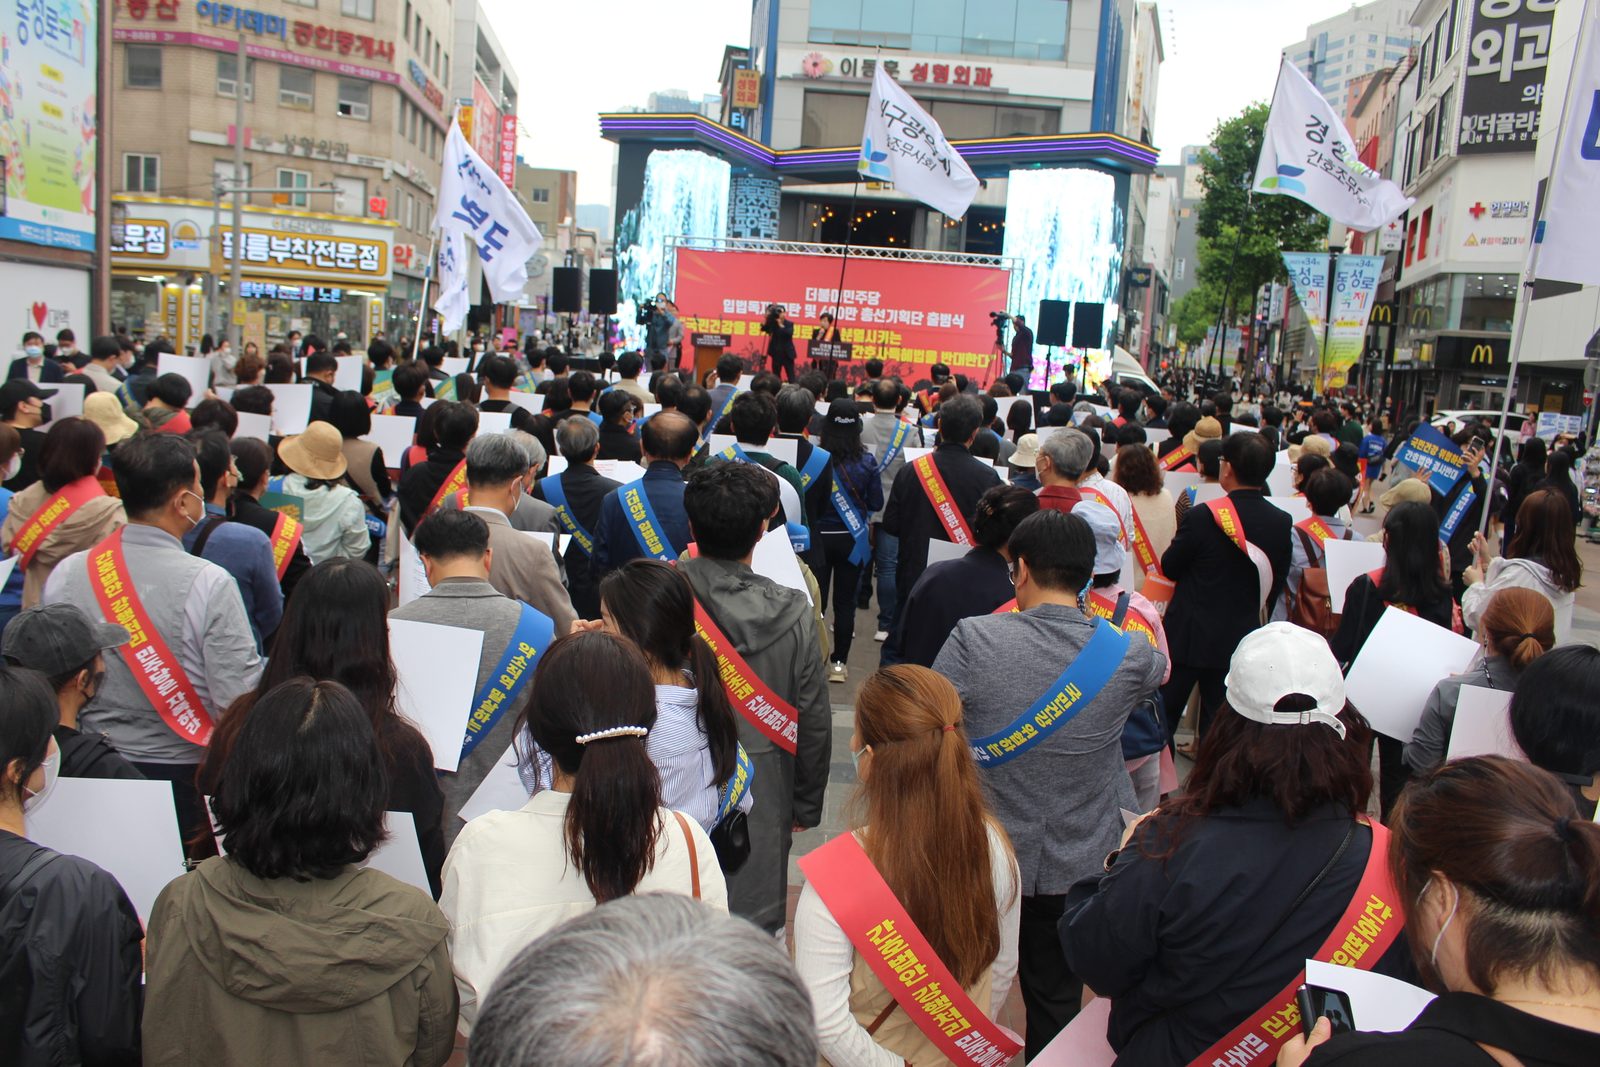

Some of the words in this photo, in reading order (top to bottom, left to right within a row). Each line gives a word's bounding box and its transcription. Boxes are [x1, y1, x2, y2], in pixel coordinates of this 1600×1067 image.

[196, 1, 287, 42] 아카데미
[294, 21, 396, 64] 공인중개사
[911, 62, 994, 88] 성형외과
[805, 287, 881, 306] 더불어민주당
[1337, 269, 1375, 292] 동성로
[927, 312, 965, 329] 출범식
[96, 550, 123, 599] 간호법안
[135, 645, 179, 697] 민주당은
[166, 691, 202, 735] 자폭하라
[499, 641, 537, 691] 약소직역
[745, 694, 789, 732] 간호법안
[1034, 682, 1083, 728] 국민건강
[986, 723, 1039, 758] 위협하는
[866, 919, 929, 988] 간호법안
[912, 982, 972, 1038] 강행처리
